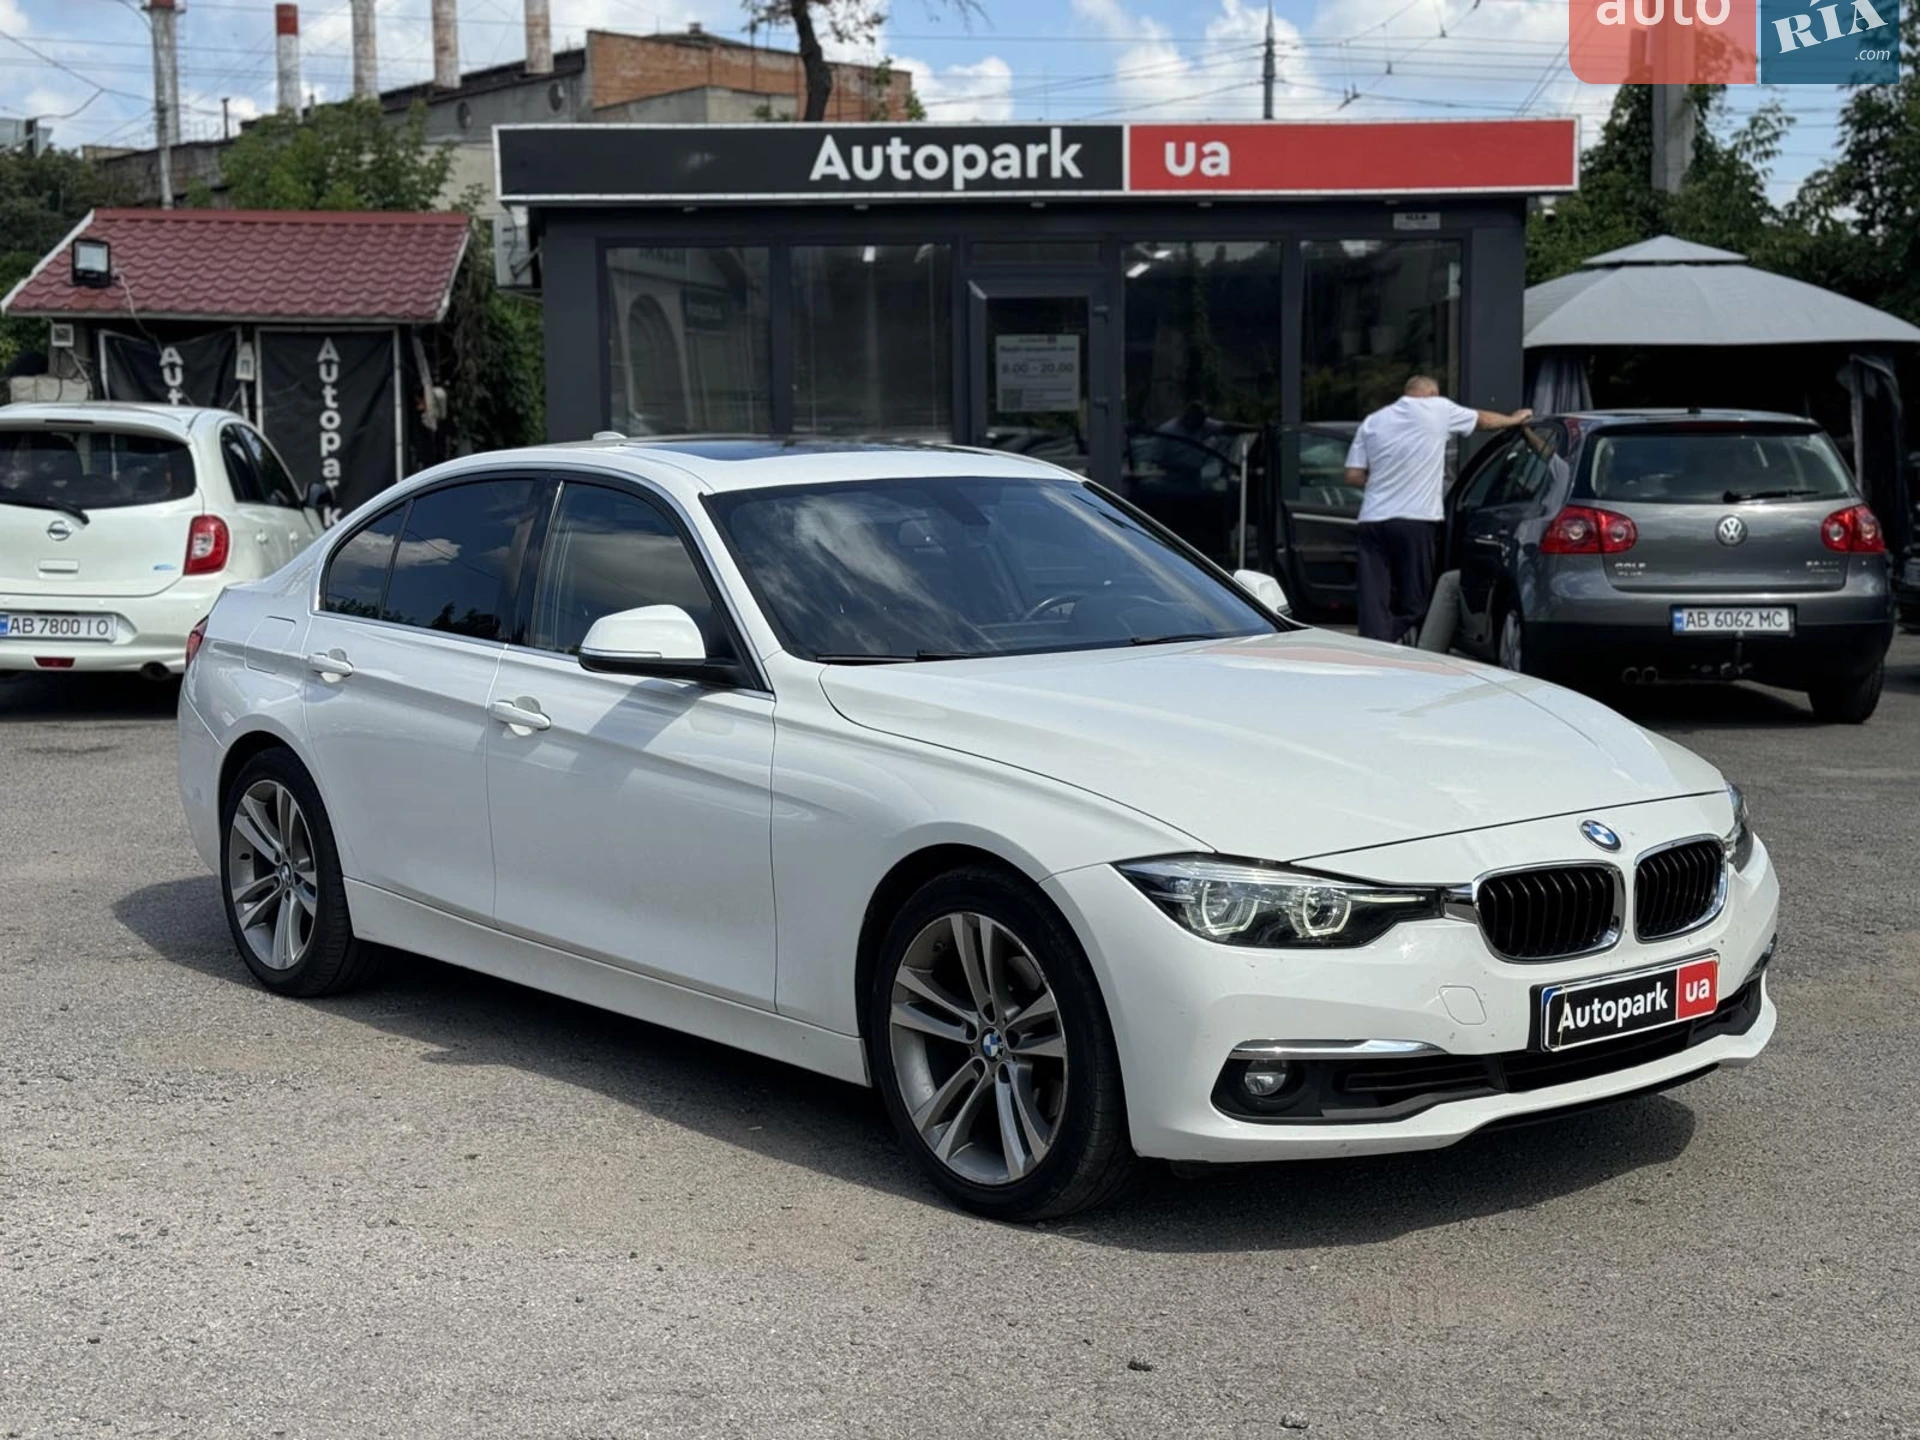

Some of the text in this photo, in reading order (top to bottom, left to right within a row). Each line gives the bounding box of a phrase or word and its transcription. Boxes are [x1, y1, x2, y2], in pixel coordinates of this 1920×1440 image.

[809, 127, 1230, 191] Autopark ua
[9, 617, 35, 634] AB
[39, 618, 81, 635] 7800
[1685, 610, 1784, 628] AB 6062 MC
[1557, 977, 1710, 1033] Autopark ua
